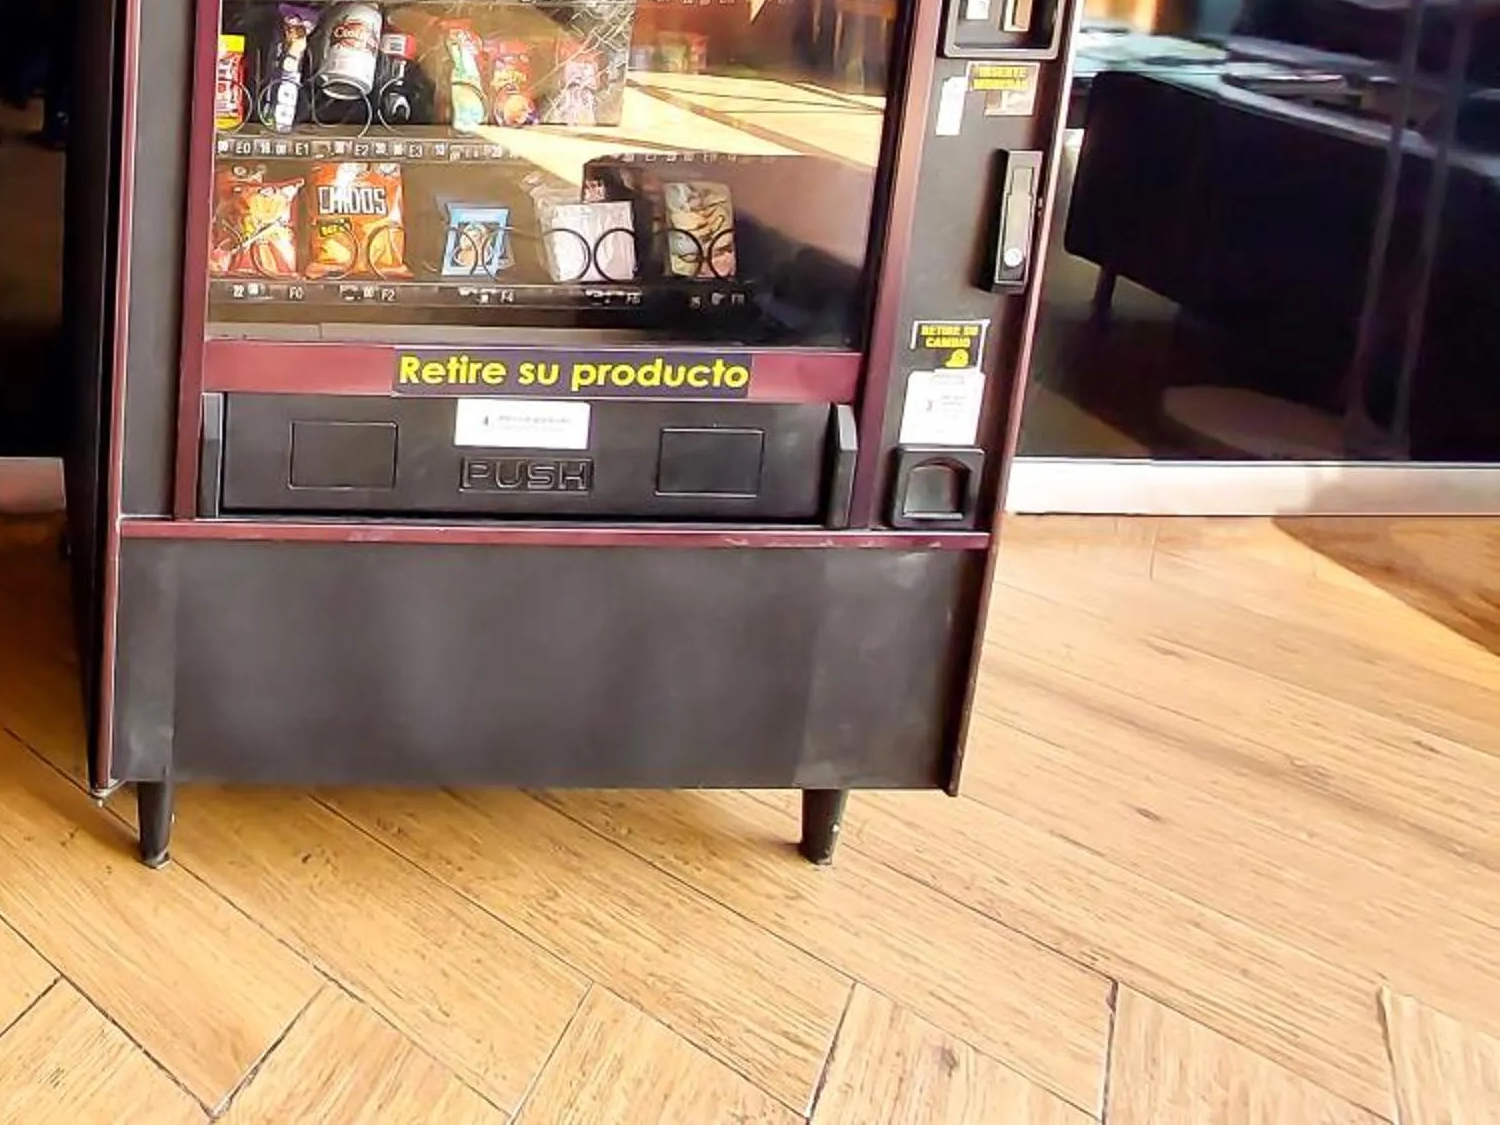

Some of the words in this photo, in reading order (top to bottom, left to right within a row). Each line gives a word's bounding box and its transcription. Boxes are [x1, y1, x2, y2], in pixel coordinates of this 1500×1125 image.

[398, 355, 507, 386] Retire
[518, 362, 560, 386] su
[570, 356, 749, 392] producto
[461, 458, 588, 490] PUSH
